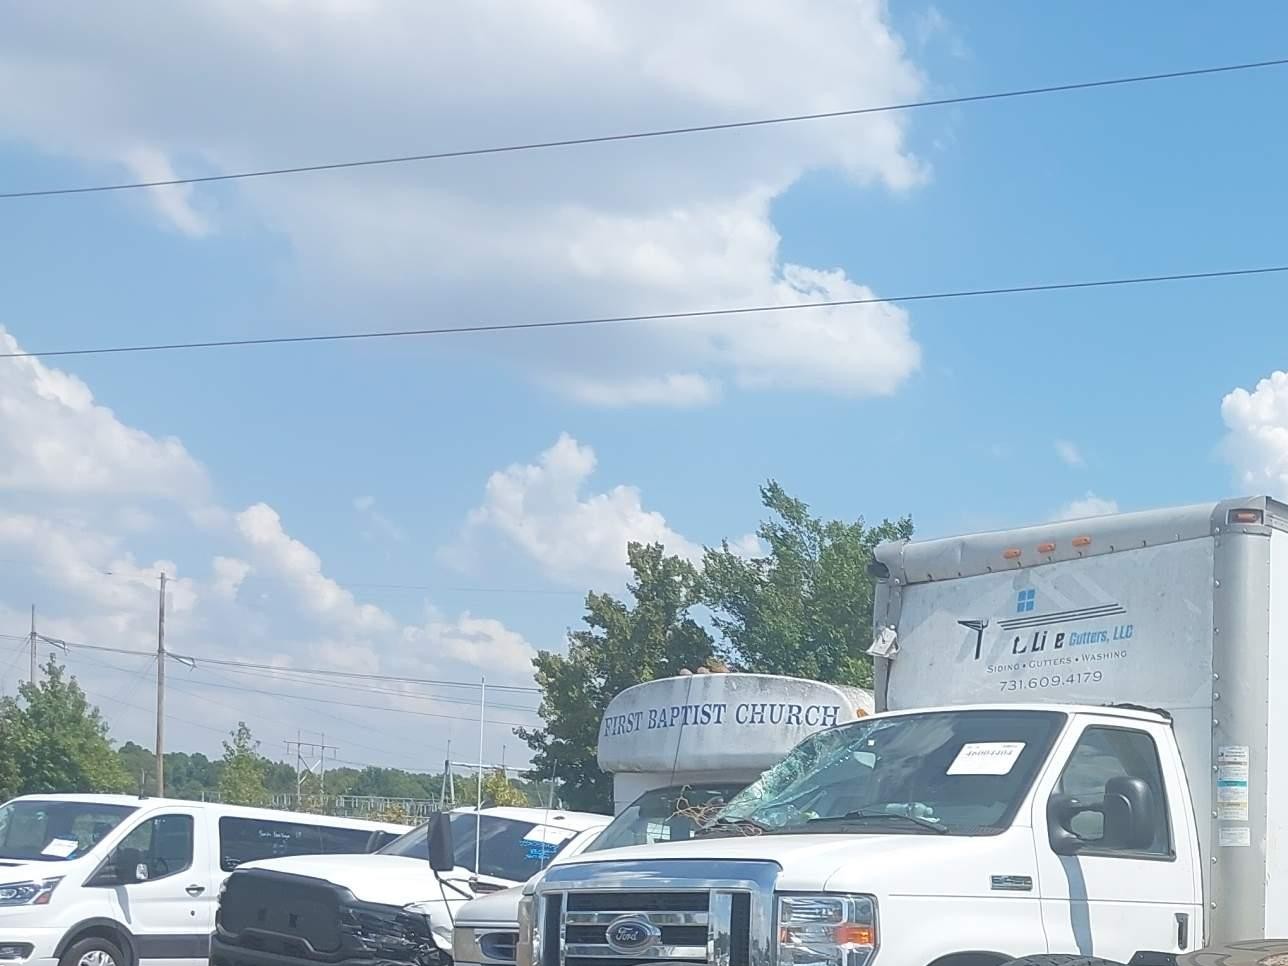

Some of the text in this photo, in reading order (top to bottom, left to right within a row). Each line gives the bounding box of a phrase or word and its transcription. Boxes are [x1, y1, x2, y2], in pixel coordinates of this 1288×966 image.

[986, 650, 1127, 674] SIDING GUTTERS WASHING
[999, 670, 1103, 692] 731.609.4179
[603, 703, 840, 737] FIRST BAPTIST CHURCH
[615, 927, 640, 941] Ford
